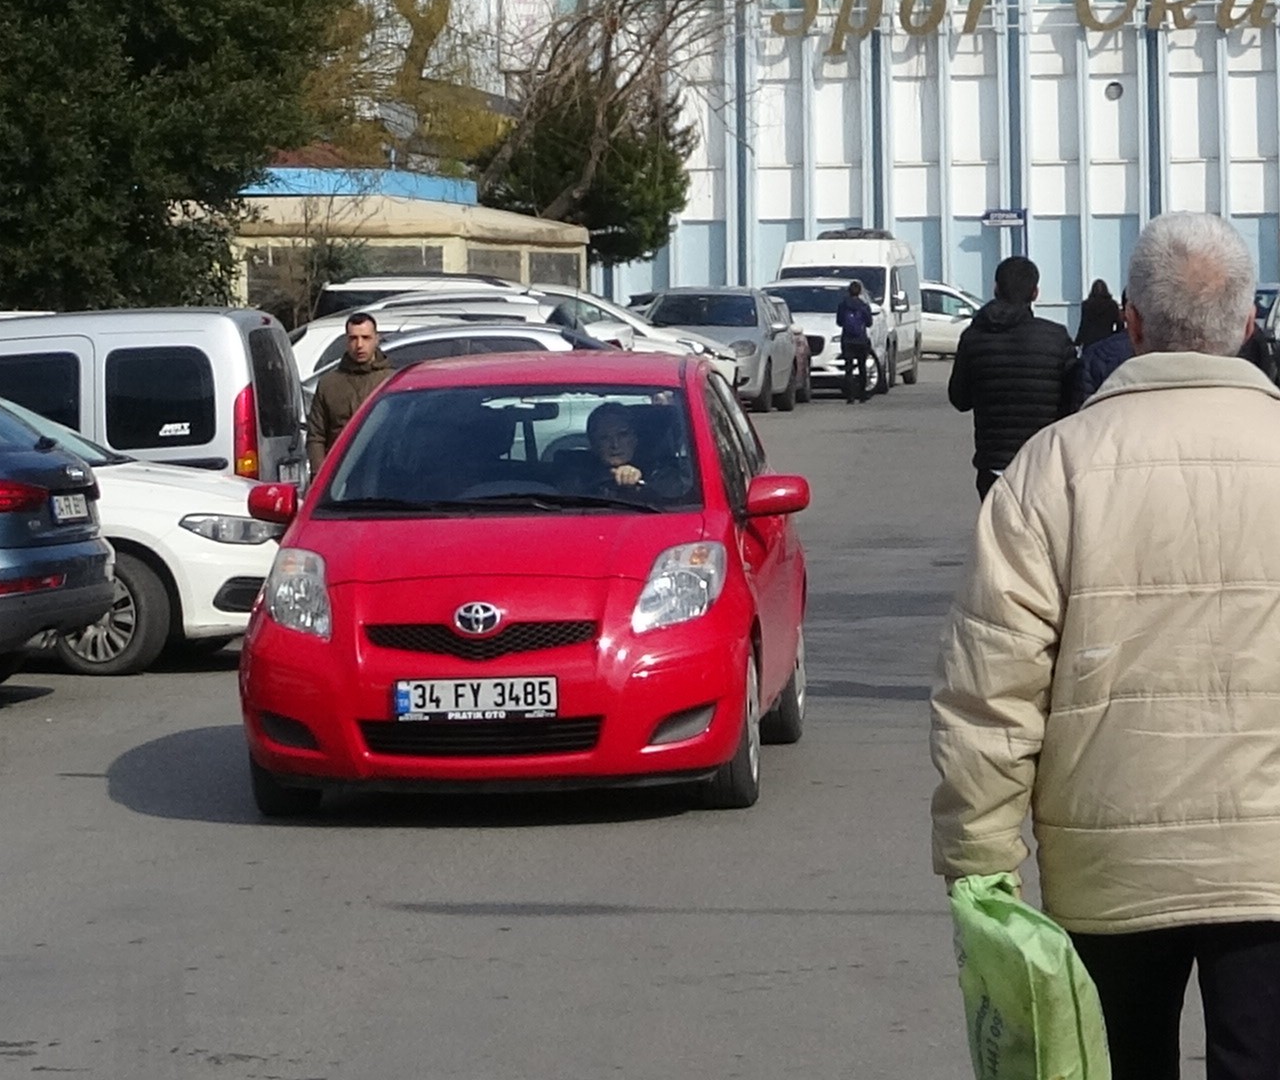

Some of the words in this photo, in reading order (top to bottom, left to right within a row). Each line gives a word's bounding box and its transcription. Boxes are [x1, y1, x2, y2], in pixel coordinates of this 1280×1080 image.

[413, 684, 441, 709] 34
[454, 682, 482, 708] FY
[493, 681, 551, 707] 3485
